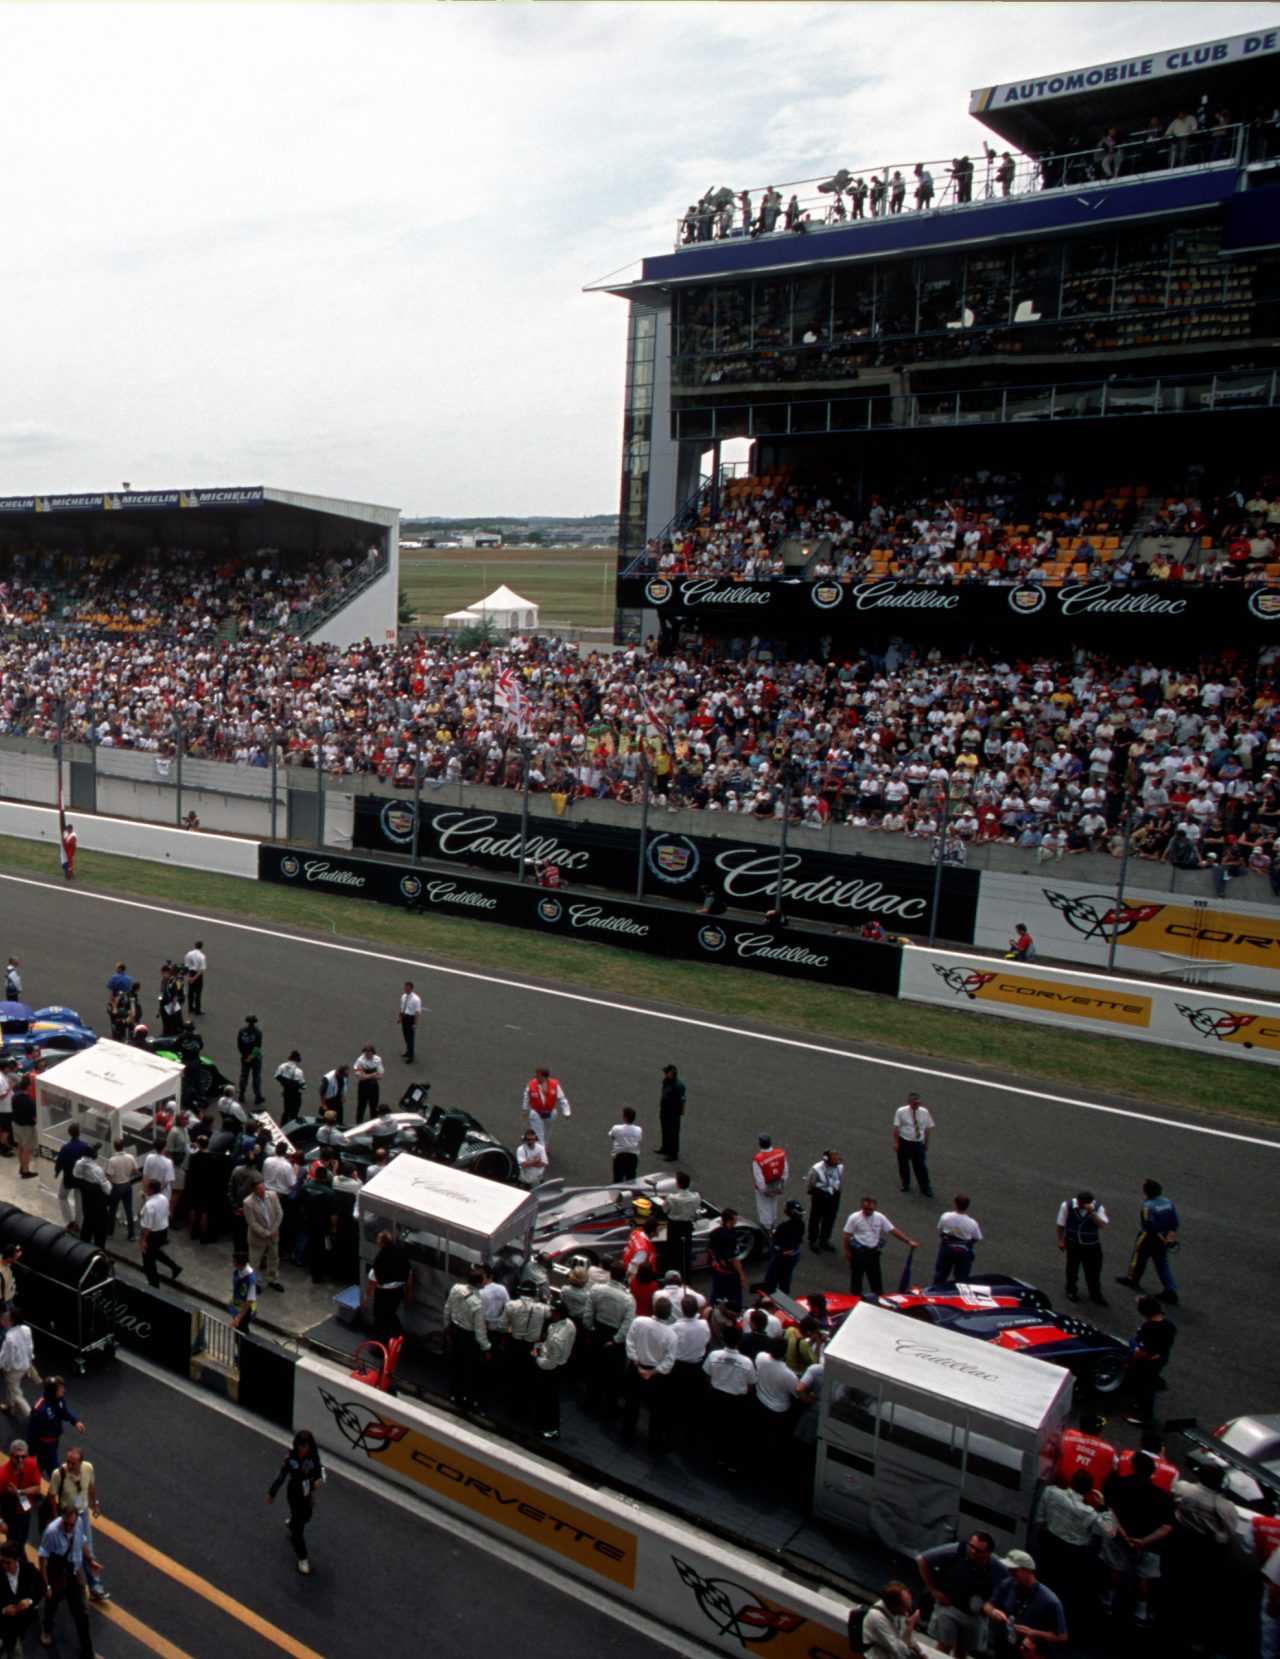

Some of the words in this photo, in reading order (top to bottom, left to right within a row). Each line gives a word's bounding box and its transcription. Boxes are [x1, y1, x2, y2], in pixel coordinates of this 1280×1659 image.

[1004, 59, 1153, 103] AUTOMOBILE
[1166, 43, 1228, 70] CLUB
[1243, 32, 1278, 54] DE
[51, 497, 103, 507] MICHELIN
[121, 494, 179, 504] MICHELIN
[199, 490, 262, 502] MICHELIN
[680, 578, 771, 605] Cadillac
[852, 580, 959, 611] Cadillac
[1057, 584, 1187, 616] Cadillac
[431, 811, 590, 870] Cadillac
[303, 860, 365, 888] Cadillac
[715, 849, 928, 919] Cadillac
[426, 880, 497, 910] Cadillac
[568, 903, 649, 937] Cadillac
[734, 932, 830, 968] Cadillac
[998, 982, 1145, 1015] CORVETTE
[894, 1338, 1000, 1383] Cadillac
[1075, 1454, 1092, 1466] PIT
[410, 1450, 626, 1562] CORVETTE
